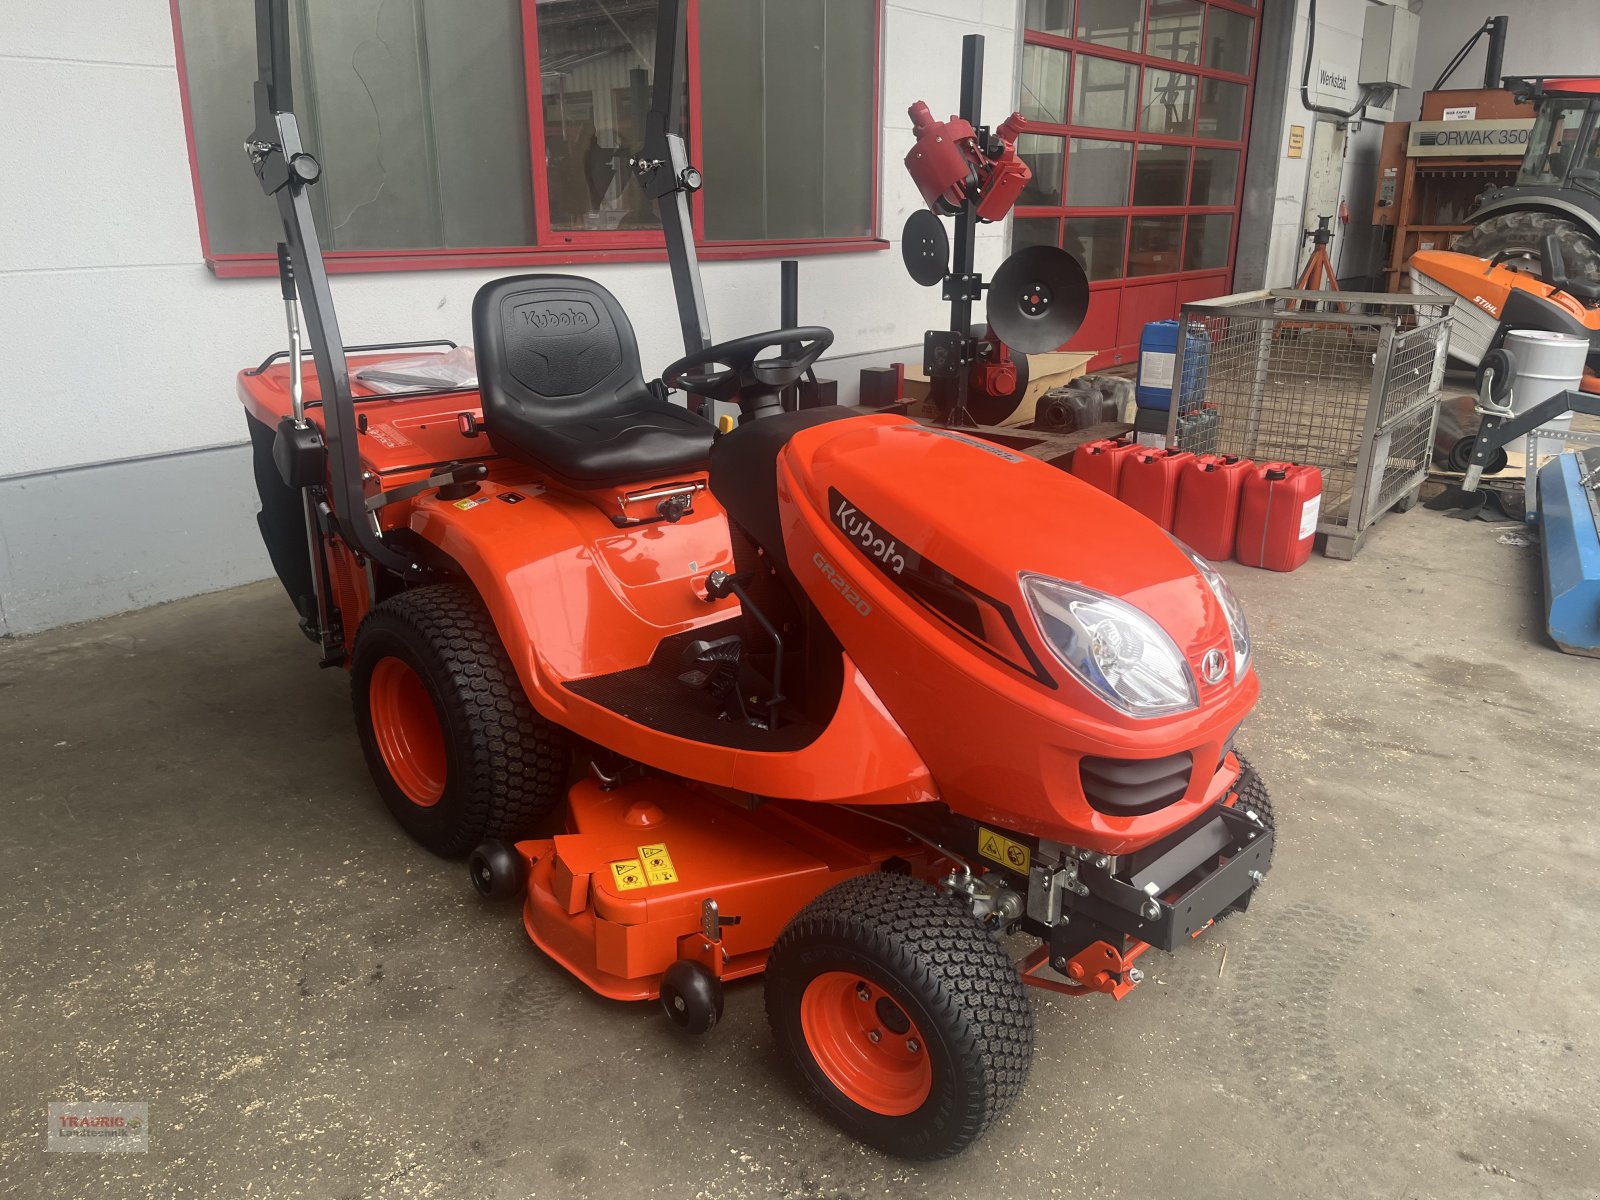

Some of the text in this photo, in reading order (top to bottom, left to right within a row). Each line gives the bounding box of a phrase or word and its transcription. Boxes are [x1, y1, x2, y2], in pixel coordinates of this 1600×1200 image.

[1320, 69, 1347, 91] Werkstatt
[1436, 131, 1495, 145] ORWAK
[1473, 295, 1497, 315] STIHL
[522, 308, 588, 329] Kubota
[836, 500, 905, 575] Kubota
[812, 551, 873, 617] GR2120
